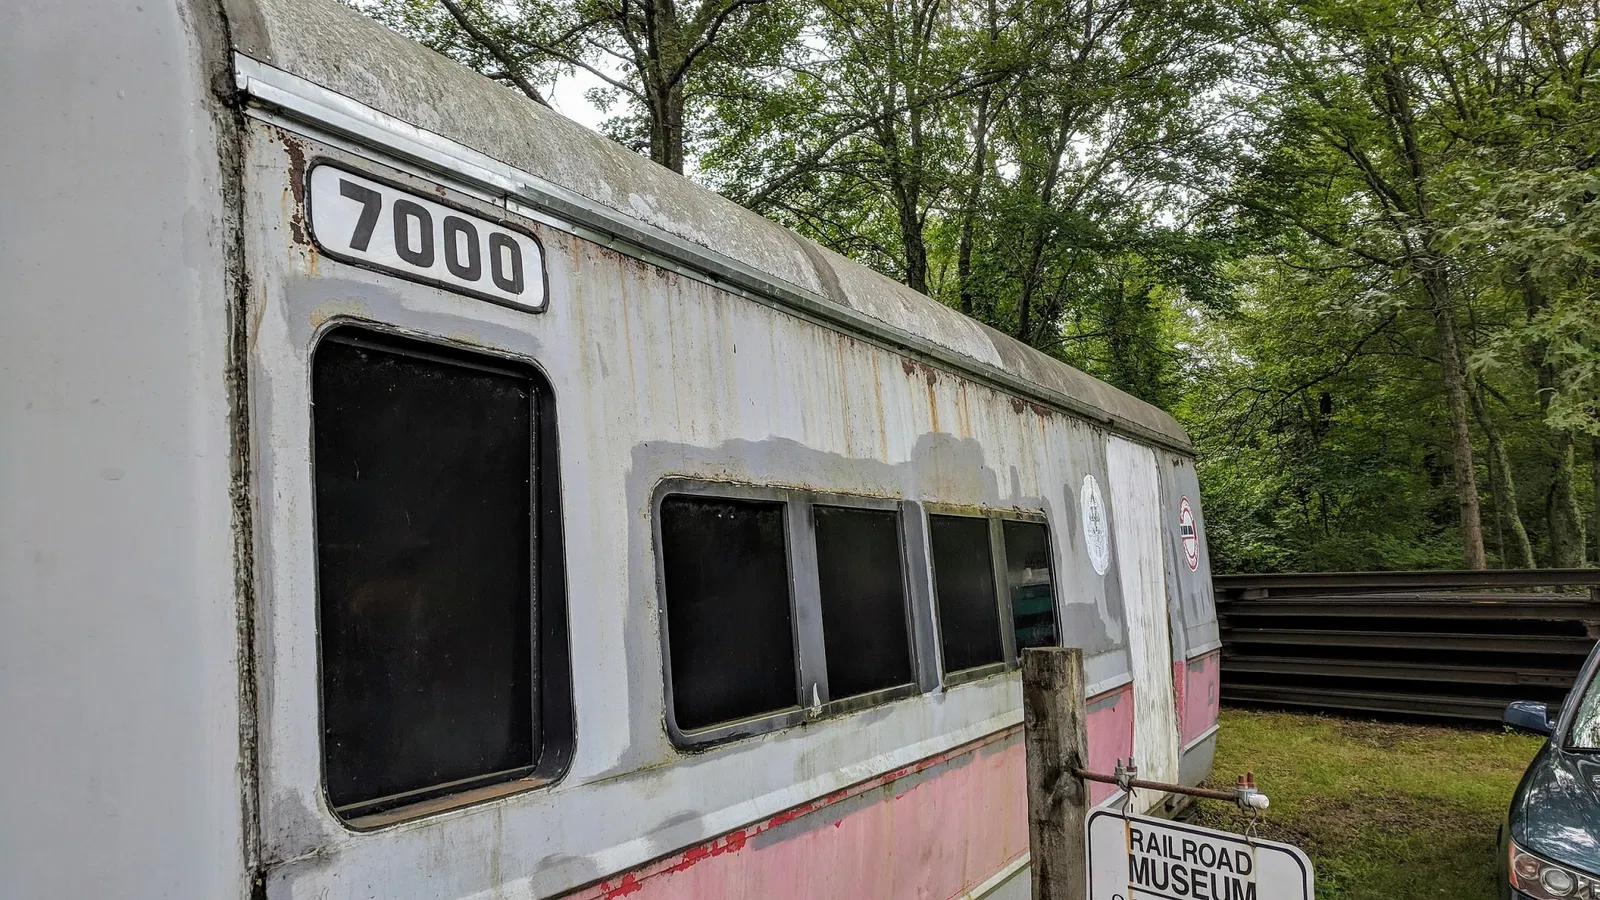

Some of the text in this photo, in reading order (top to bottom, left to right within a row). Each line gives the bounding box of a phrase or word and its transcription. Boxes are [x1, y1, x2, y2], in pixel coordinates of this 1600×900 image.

[339, 178, 525, 295] 7000
[1129, 828, 1253, 876] RAILROAD
[1128, 853, 1257, 900] MUSEUM
